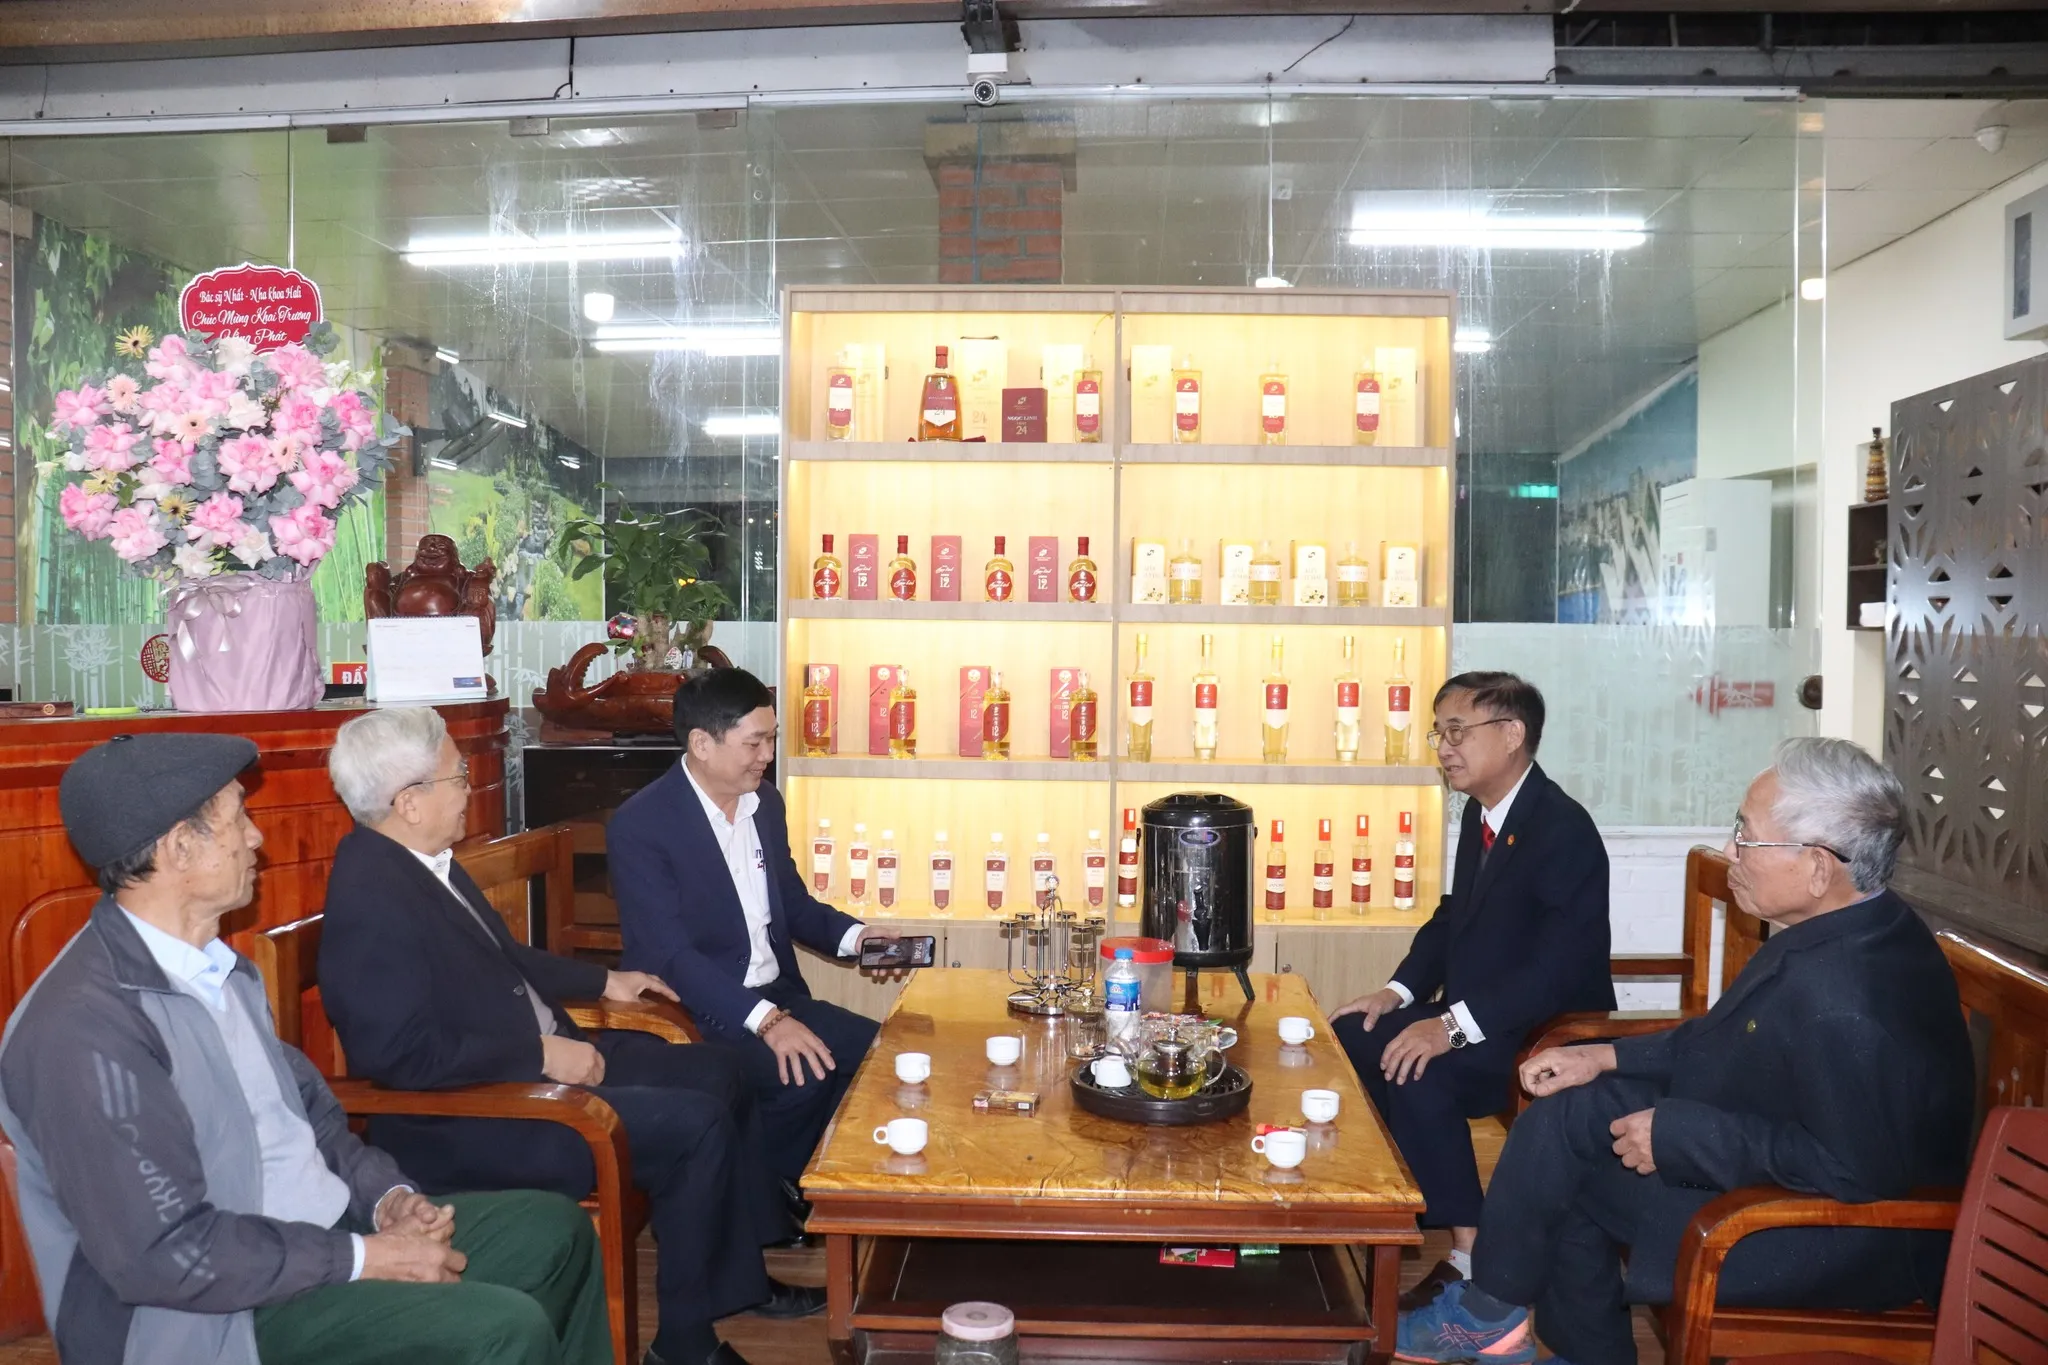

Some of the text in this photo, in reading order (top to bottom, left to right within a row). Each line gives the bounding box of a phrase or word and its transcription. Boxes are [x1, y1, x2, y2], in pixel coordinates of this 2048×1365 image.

[224, 287, 244, 304] Nhất
[250, 287, 267, 303] Nha
[192, 305, 312, 327] Chúc Mừng Khai Trương
[254, 328, 288, 345] Phát
[1016, 426, 1028, 436] 24
